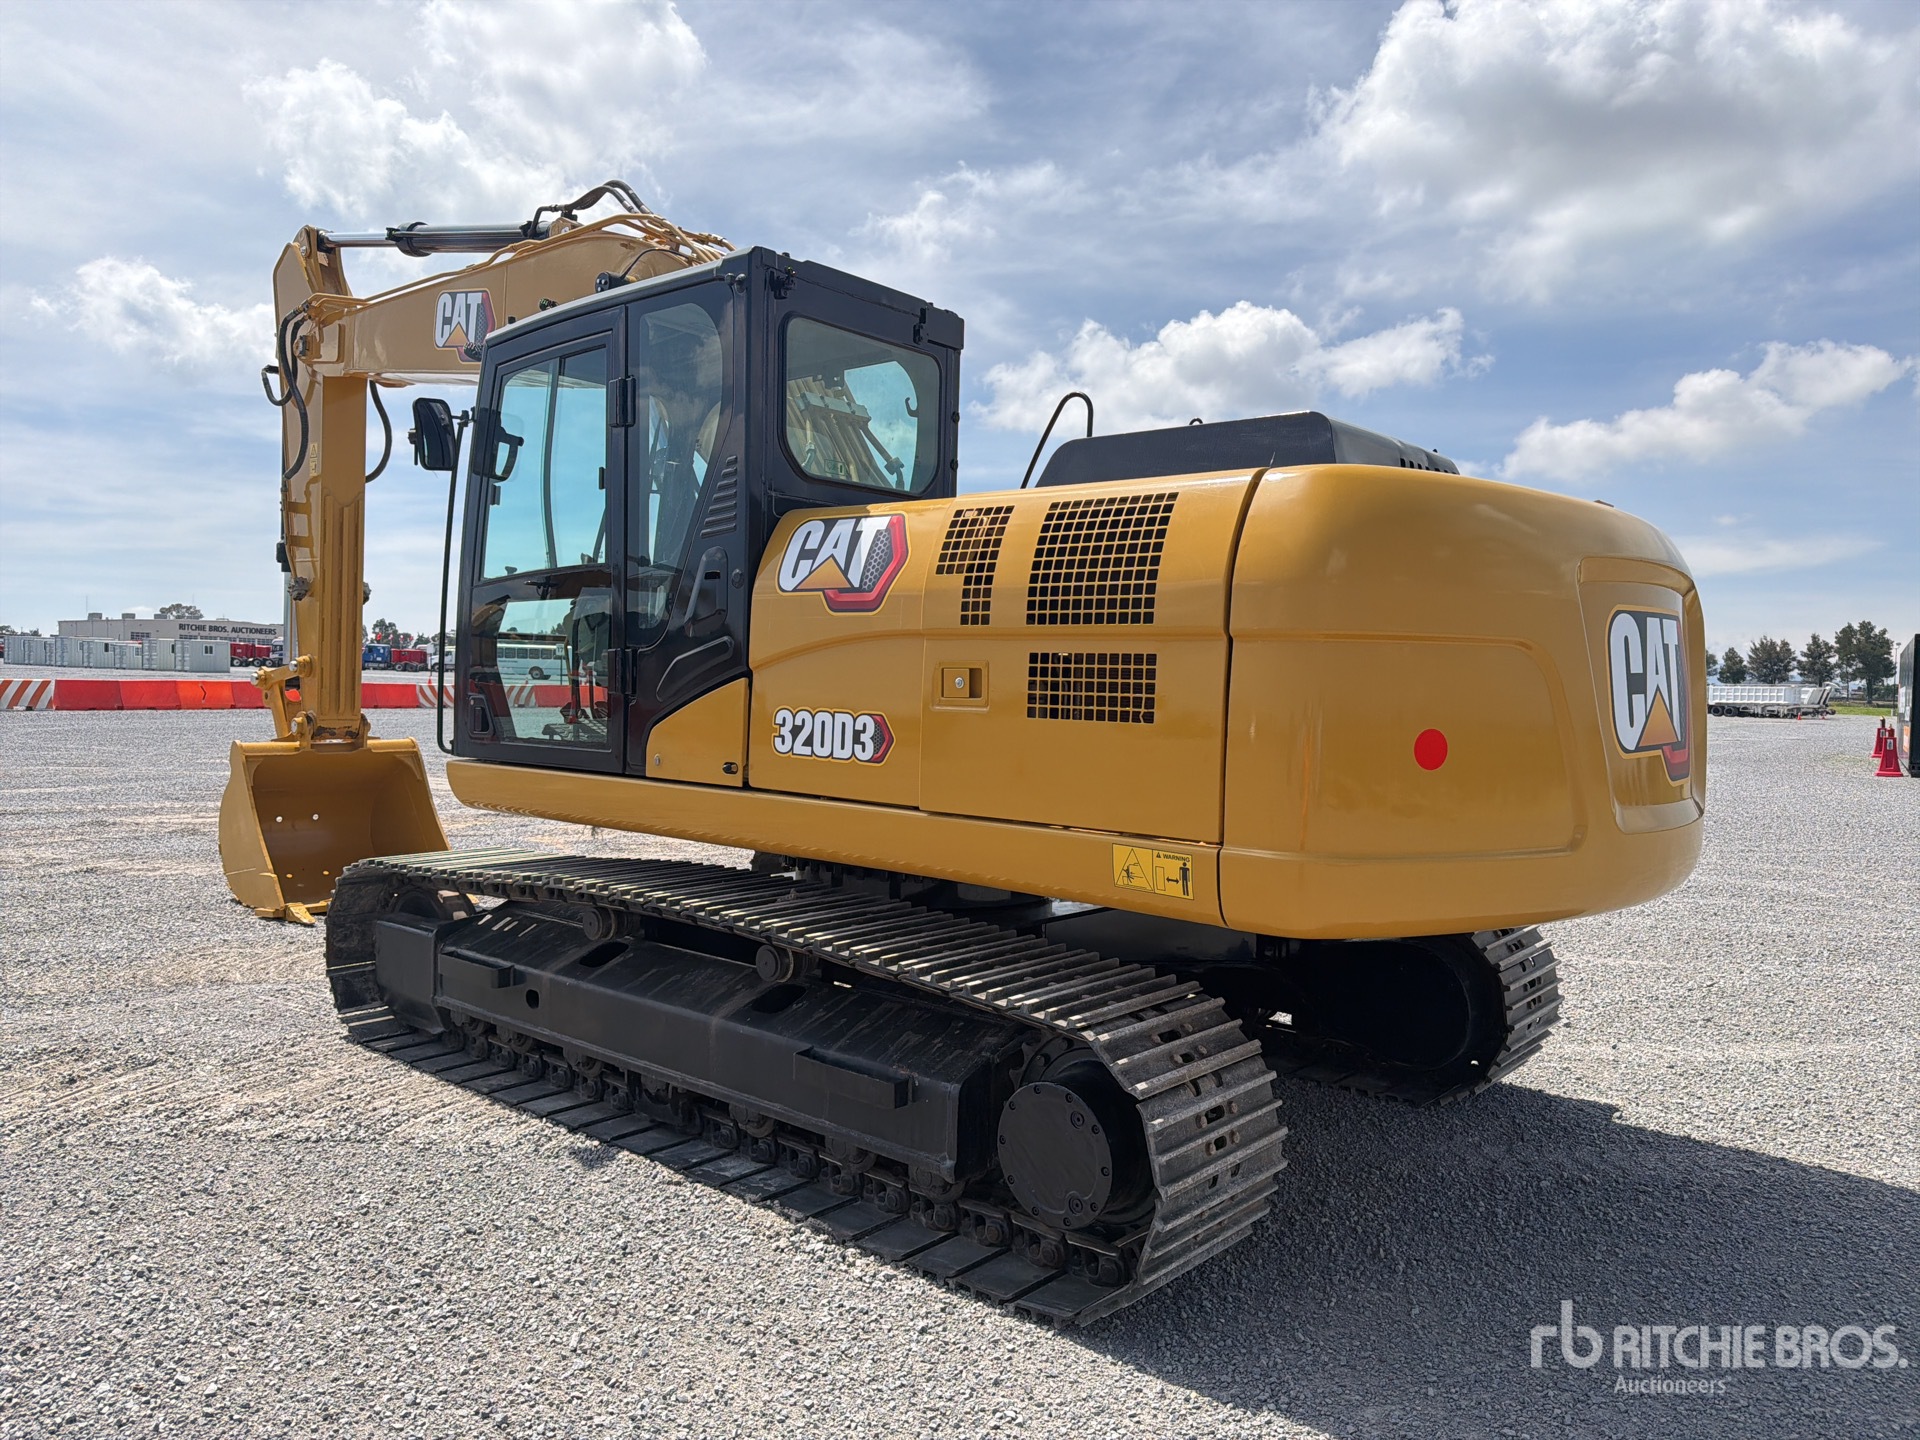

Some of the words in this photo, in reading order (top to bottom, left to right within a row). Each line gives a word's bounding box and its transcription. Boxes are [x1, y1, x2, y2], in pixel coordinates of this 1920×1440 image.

[435, 292, 483, 347] CAT
[778, 515, 892, 592] CAT
[178, 623, 207, 632] RITCHIE
[208, 625, 229, 633] BROS.
[231, 626, 277, 635] AUCTIONEERS
[1609, 612, 1682, 750] CAT
[774, 709, 876, 761] 320D3
[1163, 852, 1190, 862] WARNING
